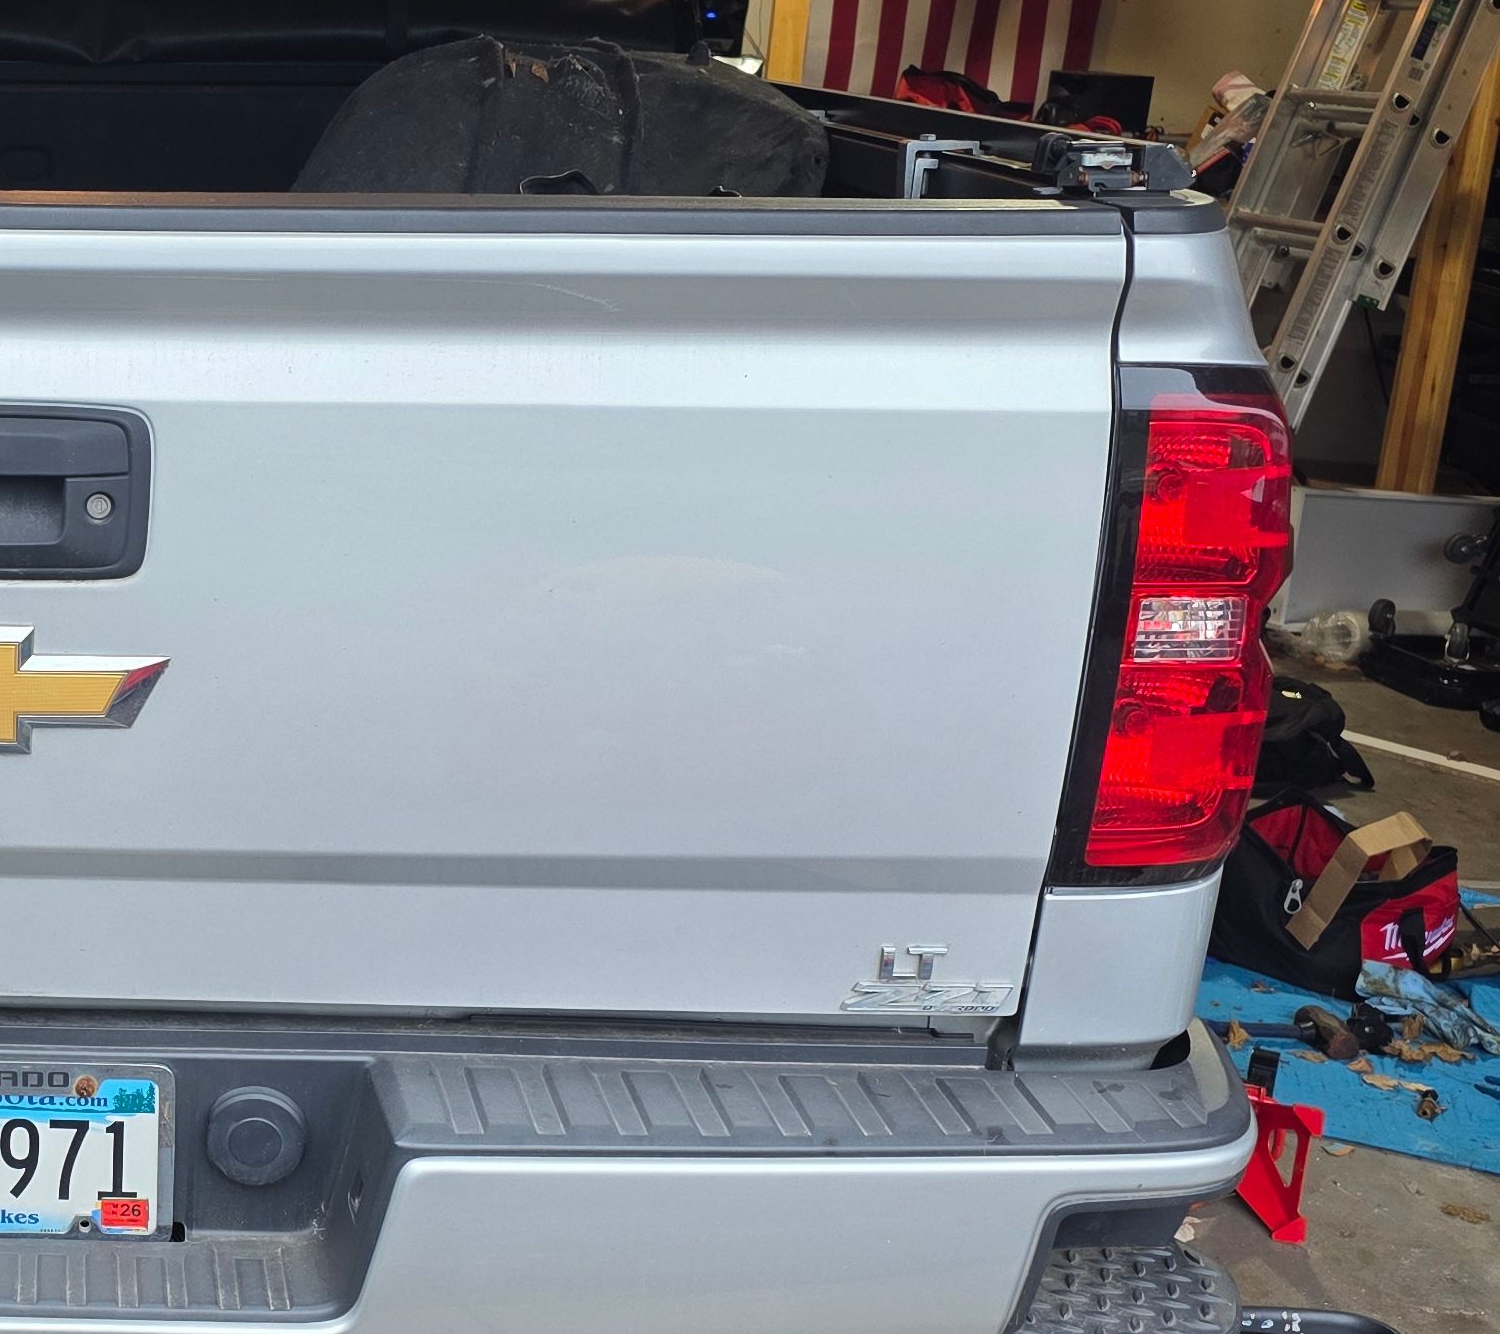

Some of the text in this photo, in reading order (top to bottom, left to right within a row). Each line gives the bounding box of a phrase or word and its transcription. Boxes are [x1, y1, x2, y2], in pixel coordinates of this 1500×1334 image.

[878, 945, 948, 981] LT
[0, 1118, 138, 1201] 971
[120, 1203, 142, 1217] 26
